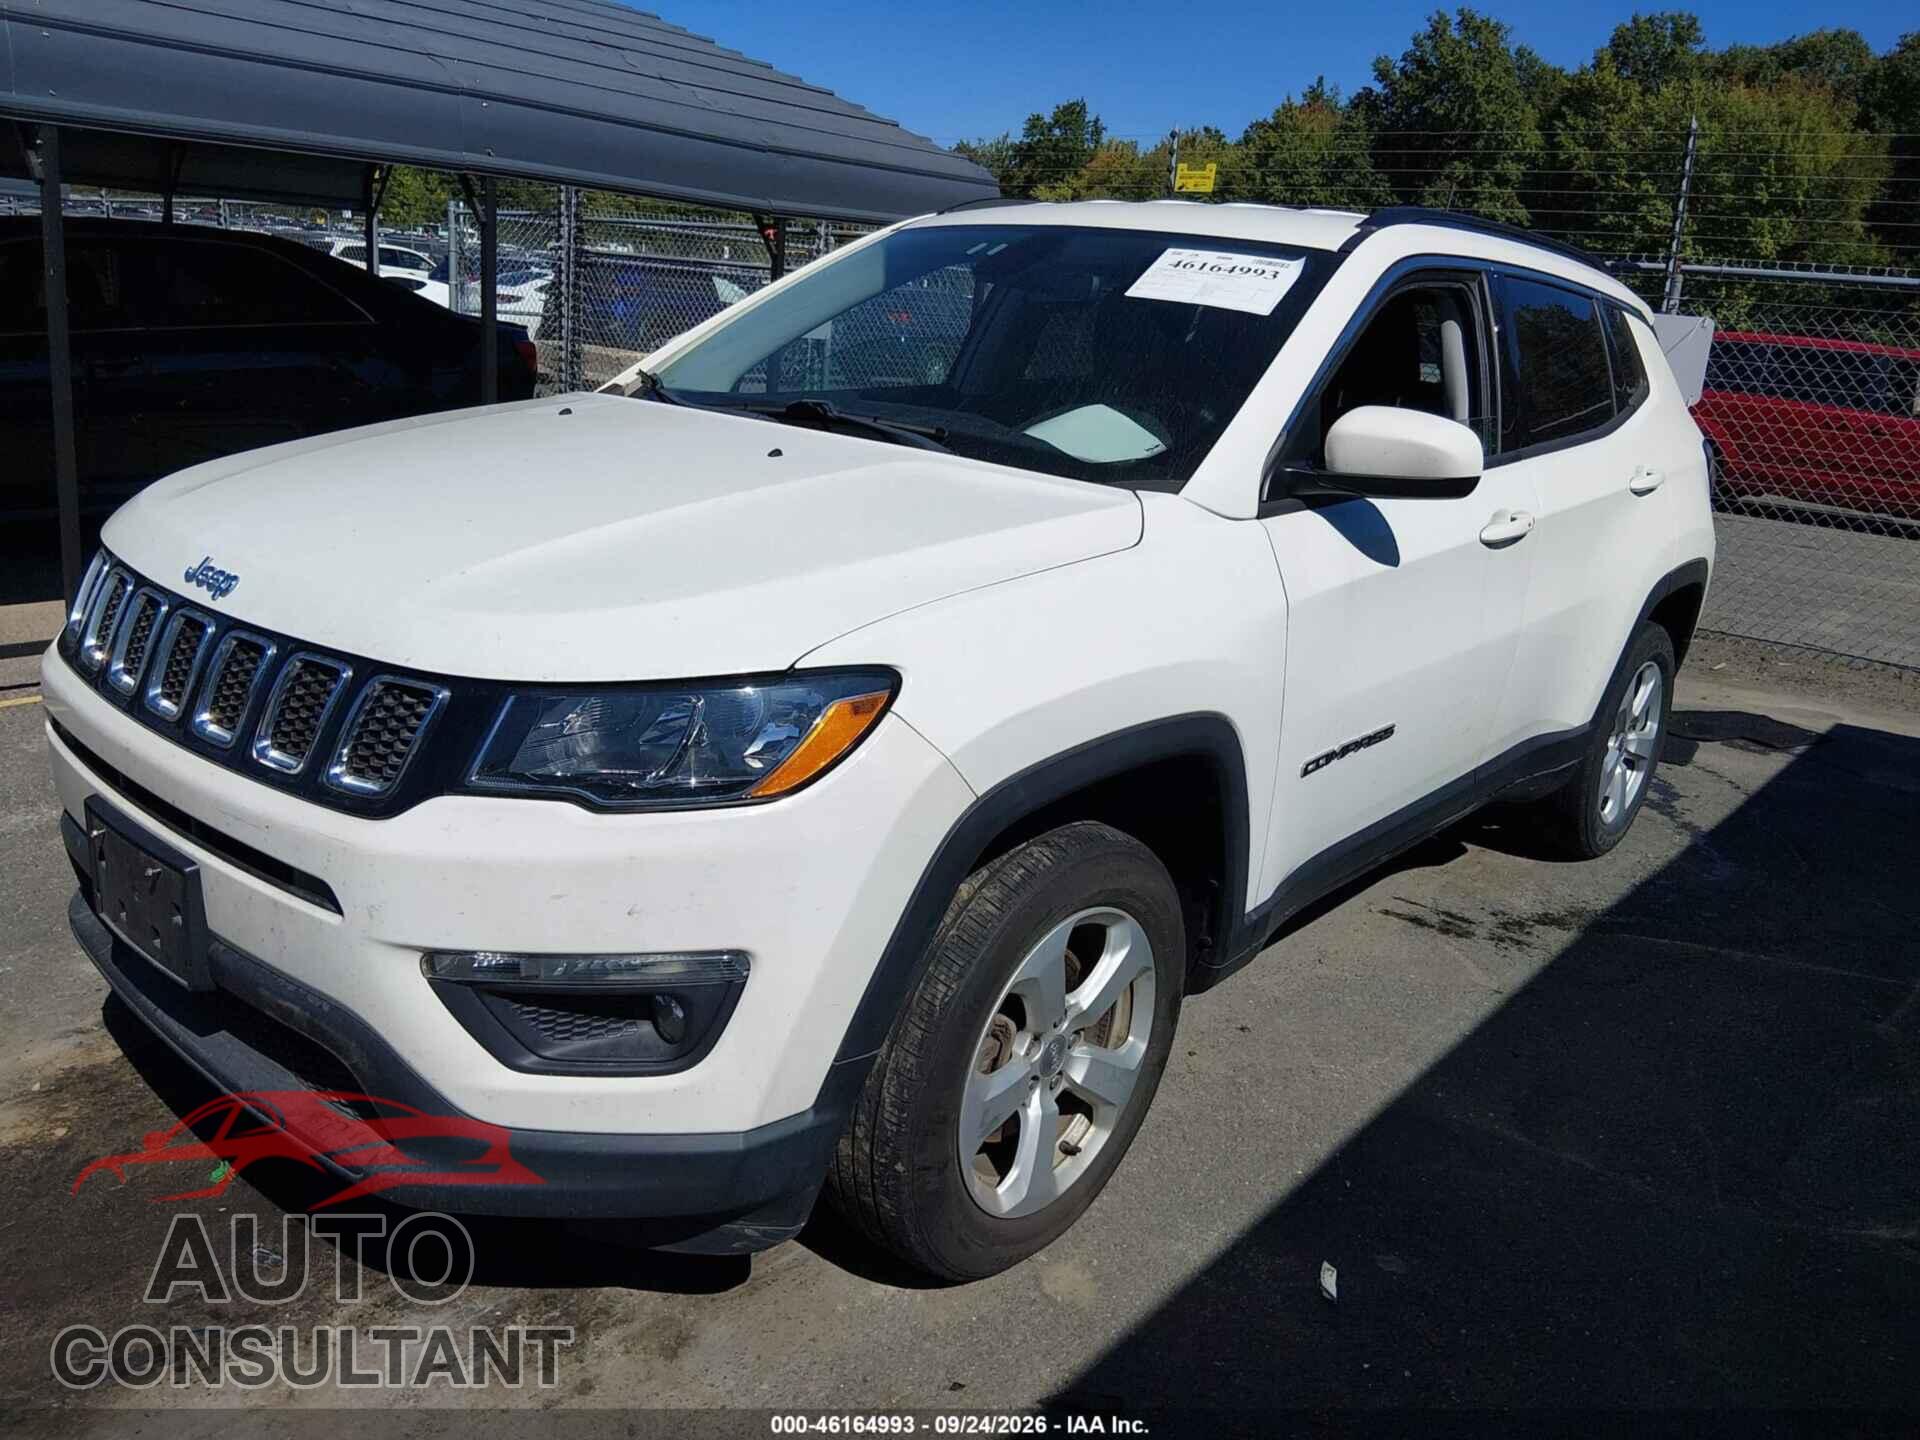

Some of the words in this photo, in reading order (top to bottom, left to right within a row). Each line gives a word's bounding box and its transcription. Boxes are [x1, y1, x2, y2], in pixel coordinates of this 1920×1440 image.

[1168, 259, 1280, 281] 46164993
[184, 556, 240, 601] Jeep
[1300, 724, 1396, 778] COMPASS
